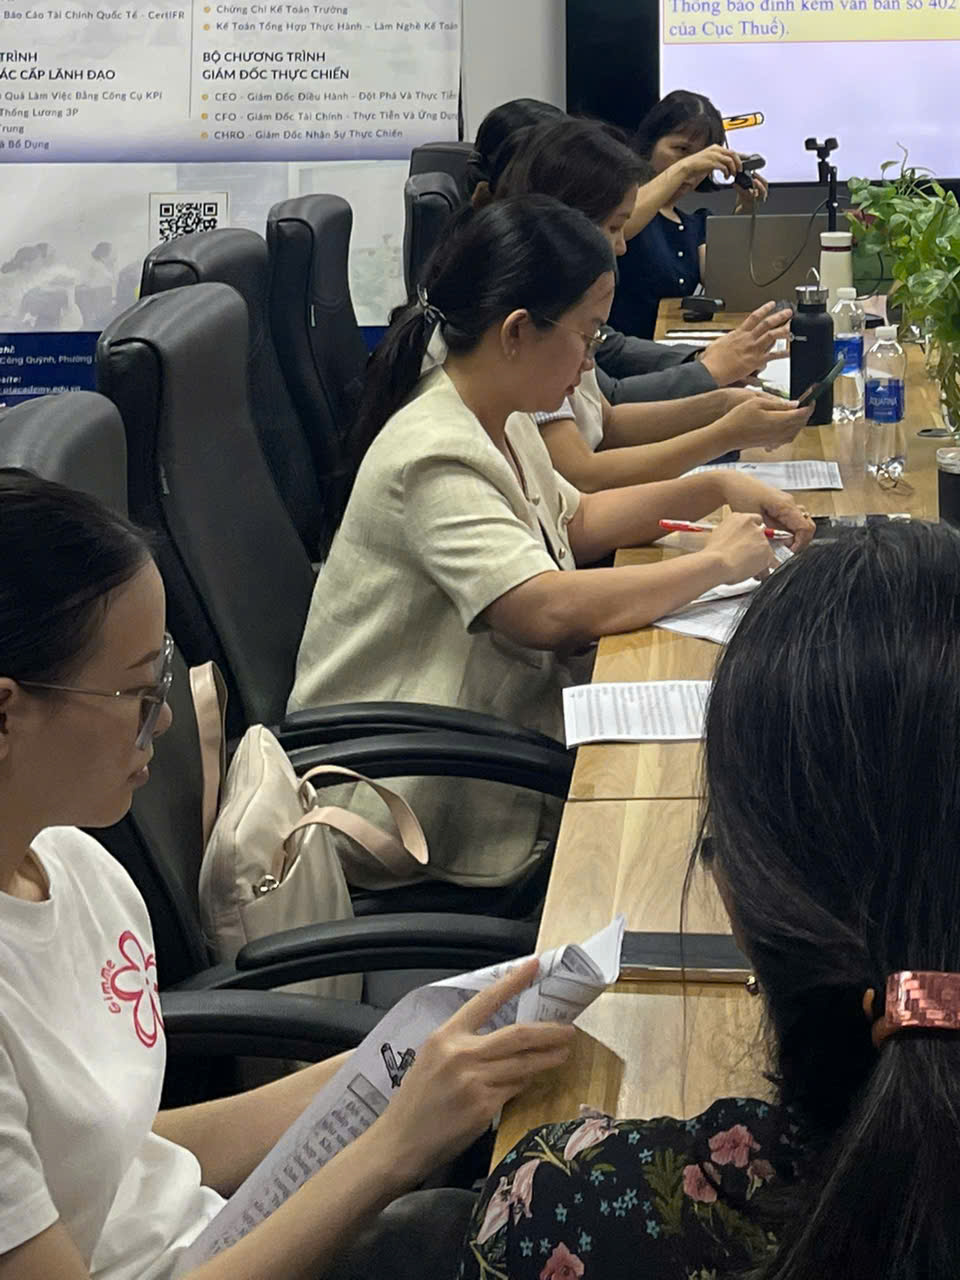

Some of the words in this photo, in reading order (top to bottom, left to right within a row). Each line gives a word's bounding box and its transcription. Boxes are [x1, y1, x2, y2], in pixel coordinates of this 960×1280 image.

[702, 20, 733, 38] Cục
[738, 17, 789, 38] Thuế).
[0, 50, 37, 62] TRÌNH
[203, 50, 221, 64] BỘ
[224, 51, 283, 62] CHƯƠNG
[287, 49, 325, 62] TRÌNH
[20, 66, 45, 80] CẤP
[49, 68, 83, 80] LÃNH
[87, 69, 115, 82] ĐẠO
[202, 67, 235, 80] GIÁM
[239, 67, 267, 80] ĐỐC
[271, 69, 307, 81] THỰC
[311, 66, 349, 79] CHIẾN
